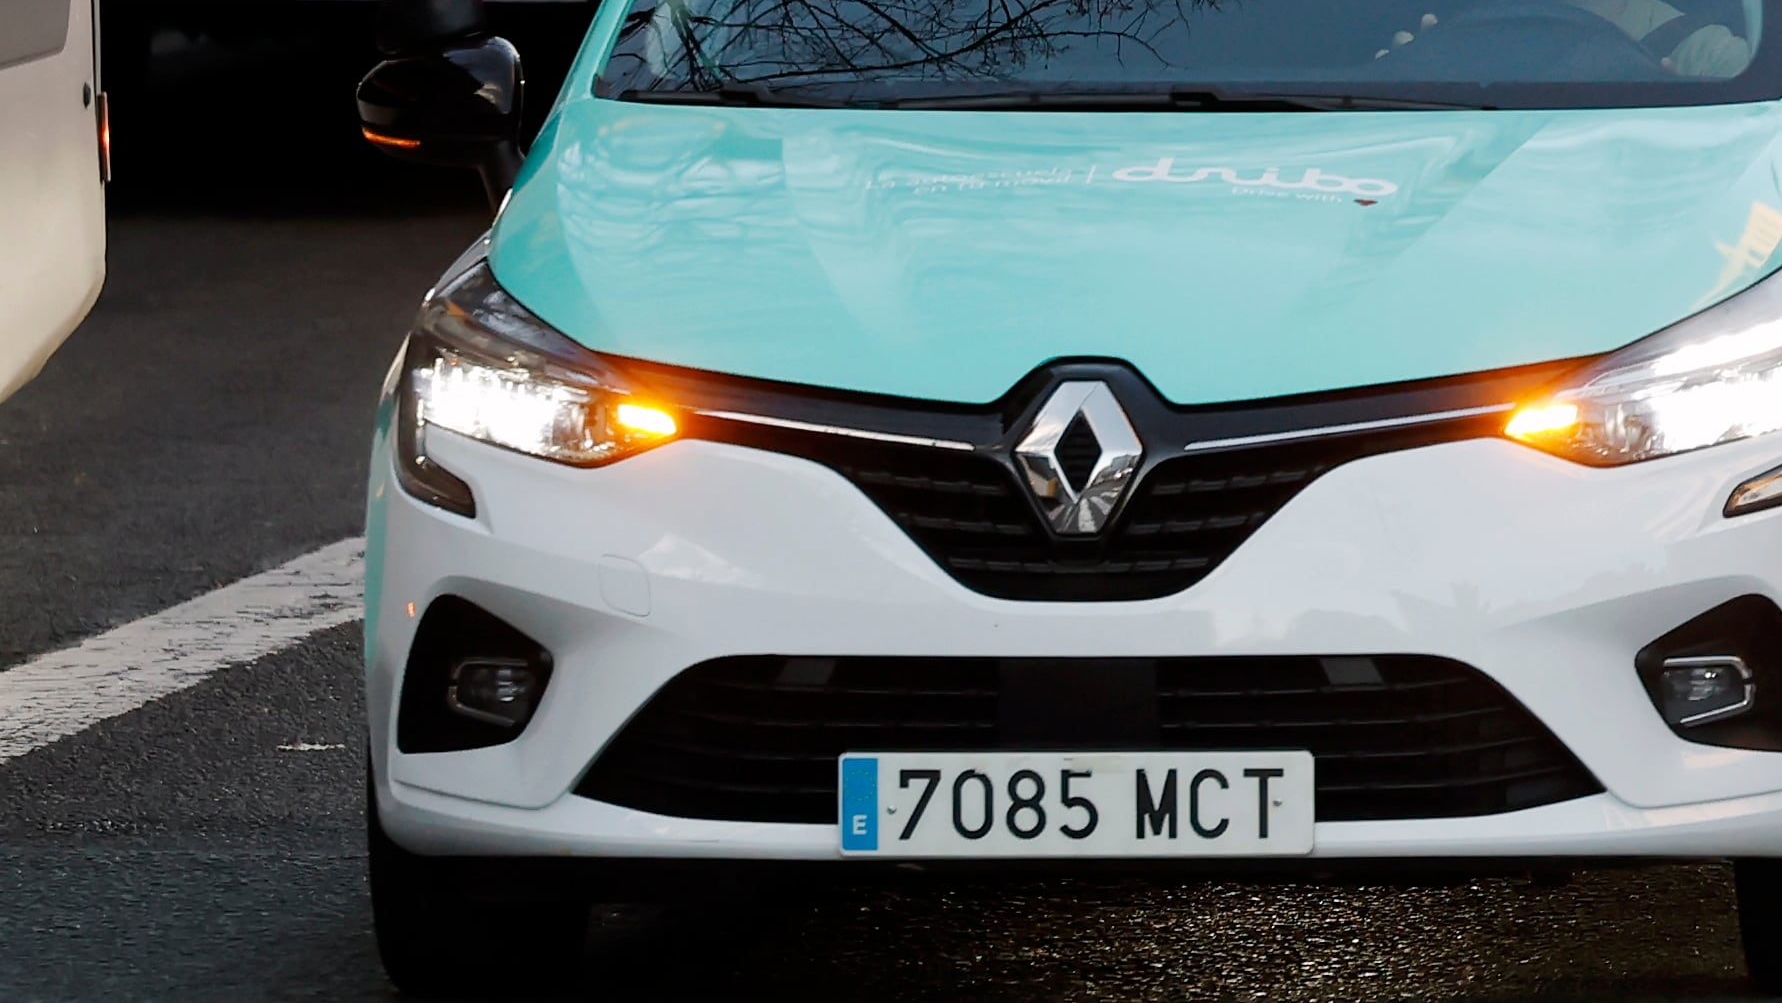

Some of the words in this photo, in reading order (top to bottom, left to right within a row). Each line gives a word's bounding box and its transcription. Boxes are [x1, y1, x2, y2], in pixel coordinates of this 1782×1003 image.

[852, 814, 868, 835] E
[898, 769, 1099, 840] 7085
[1135, 768, 1285, 840] MCT
